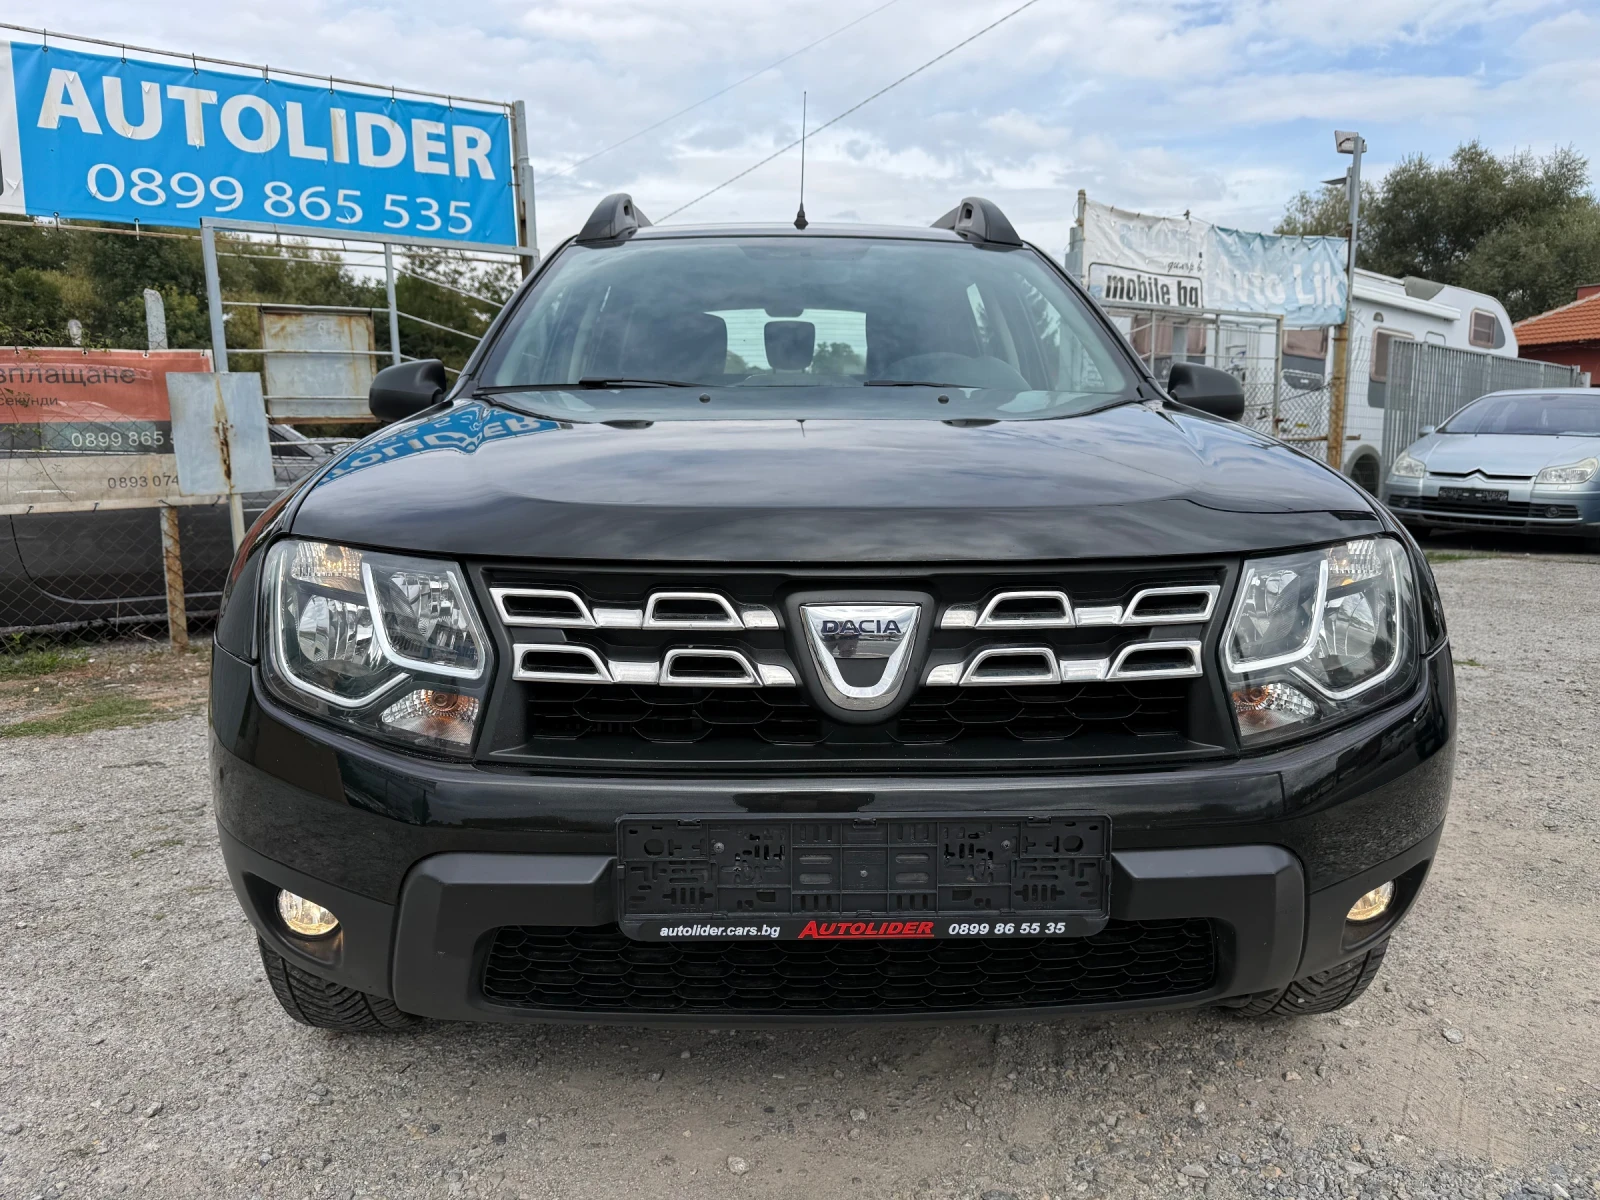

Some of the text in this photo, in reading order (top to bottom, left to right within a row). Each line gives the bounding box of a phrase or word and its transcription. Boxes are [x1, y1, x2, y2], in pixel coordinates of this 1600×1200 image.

[37, 68, 496, 180] AUTOLIDER
[87, 163, 473, 235] 0899 865 535
[71, 432, 122, 447] 0899
[128, 431, 164, 446] 865
[107, 476, 148, 489] 0893
[821, 620, 902, 634] DACIA
[659, 920, 1066, 938] autolider.cars.bg AUTOLIDER 0899 86 55 35
